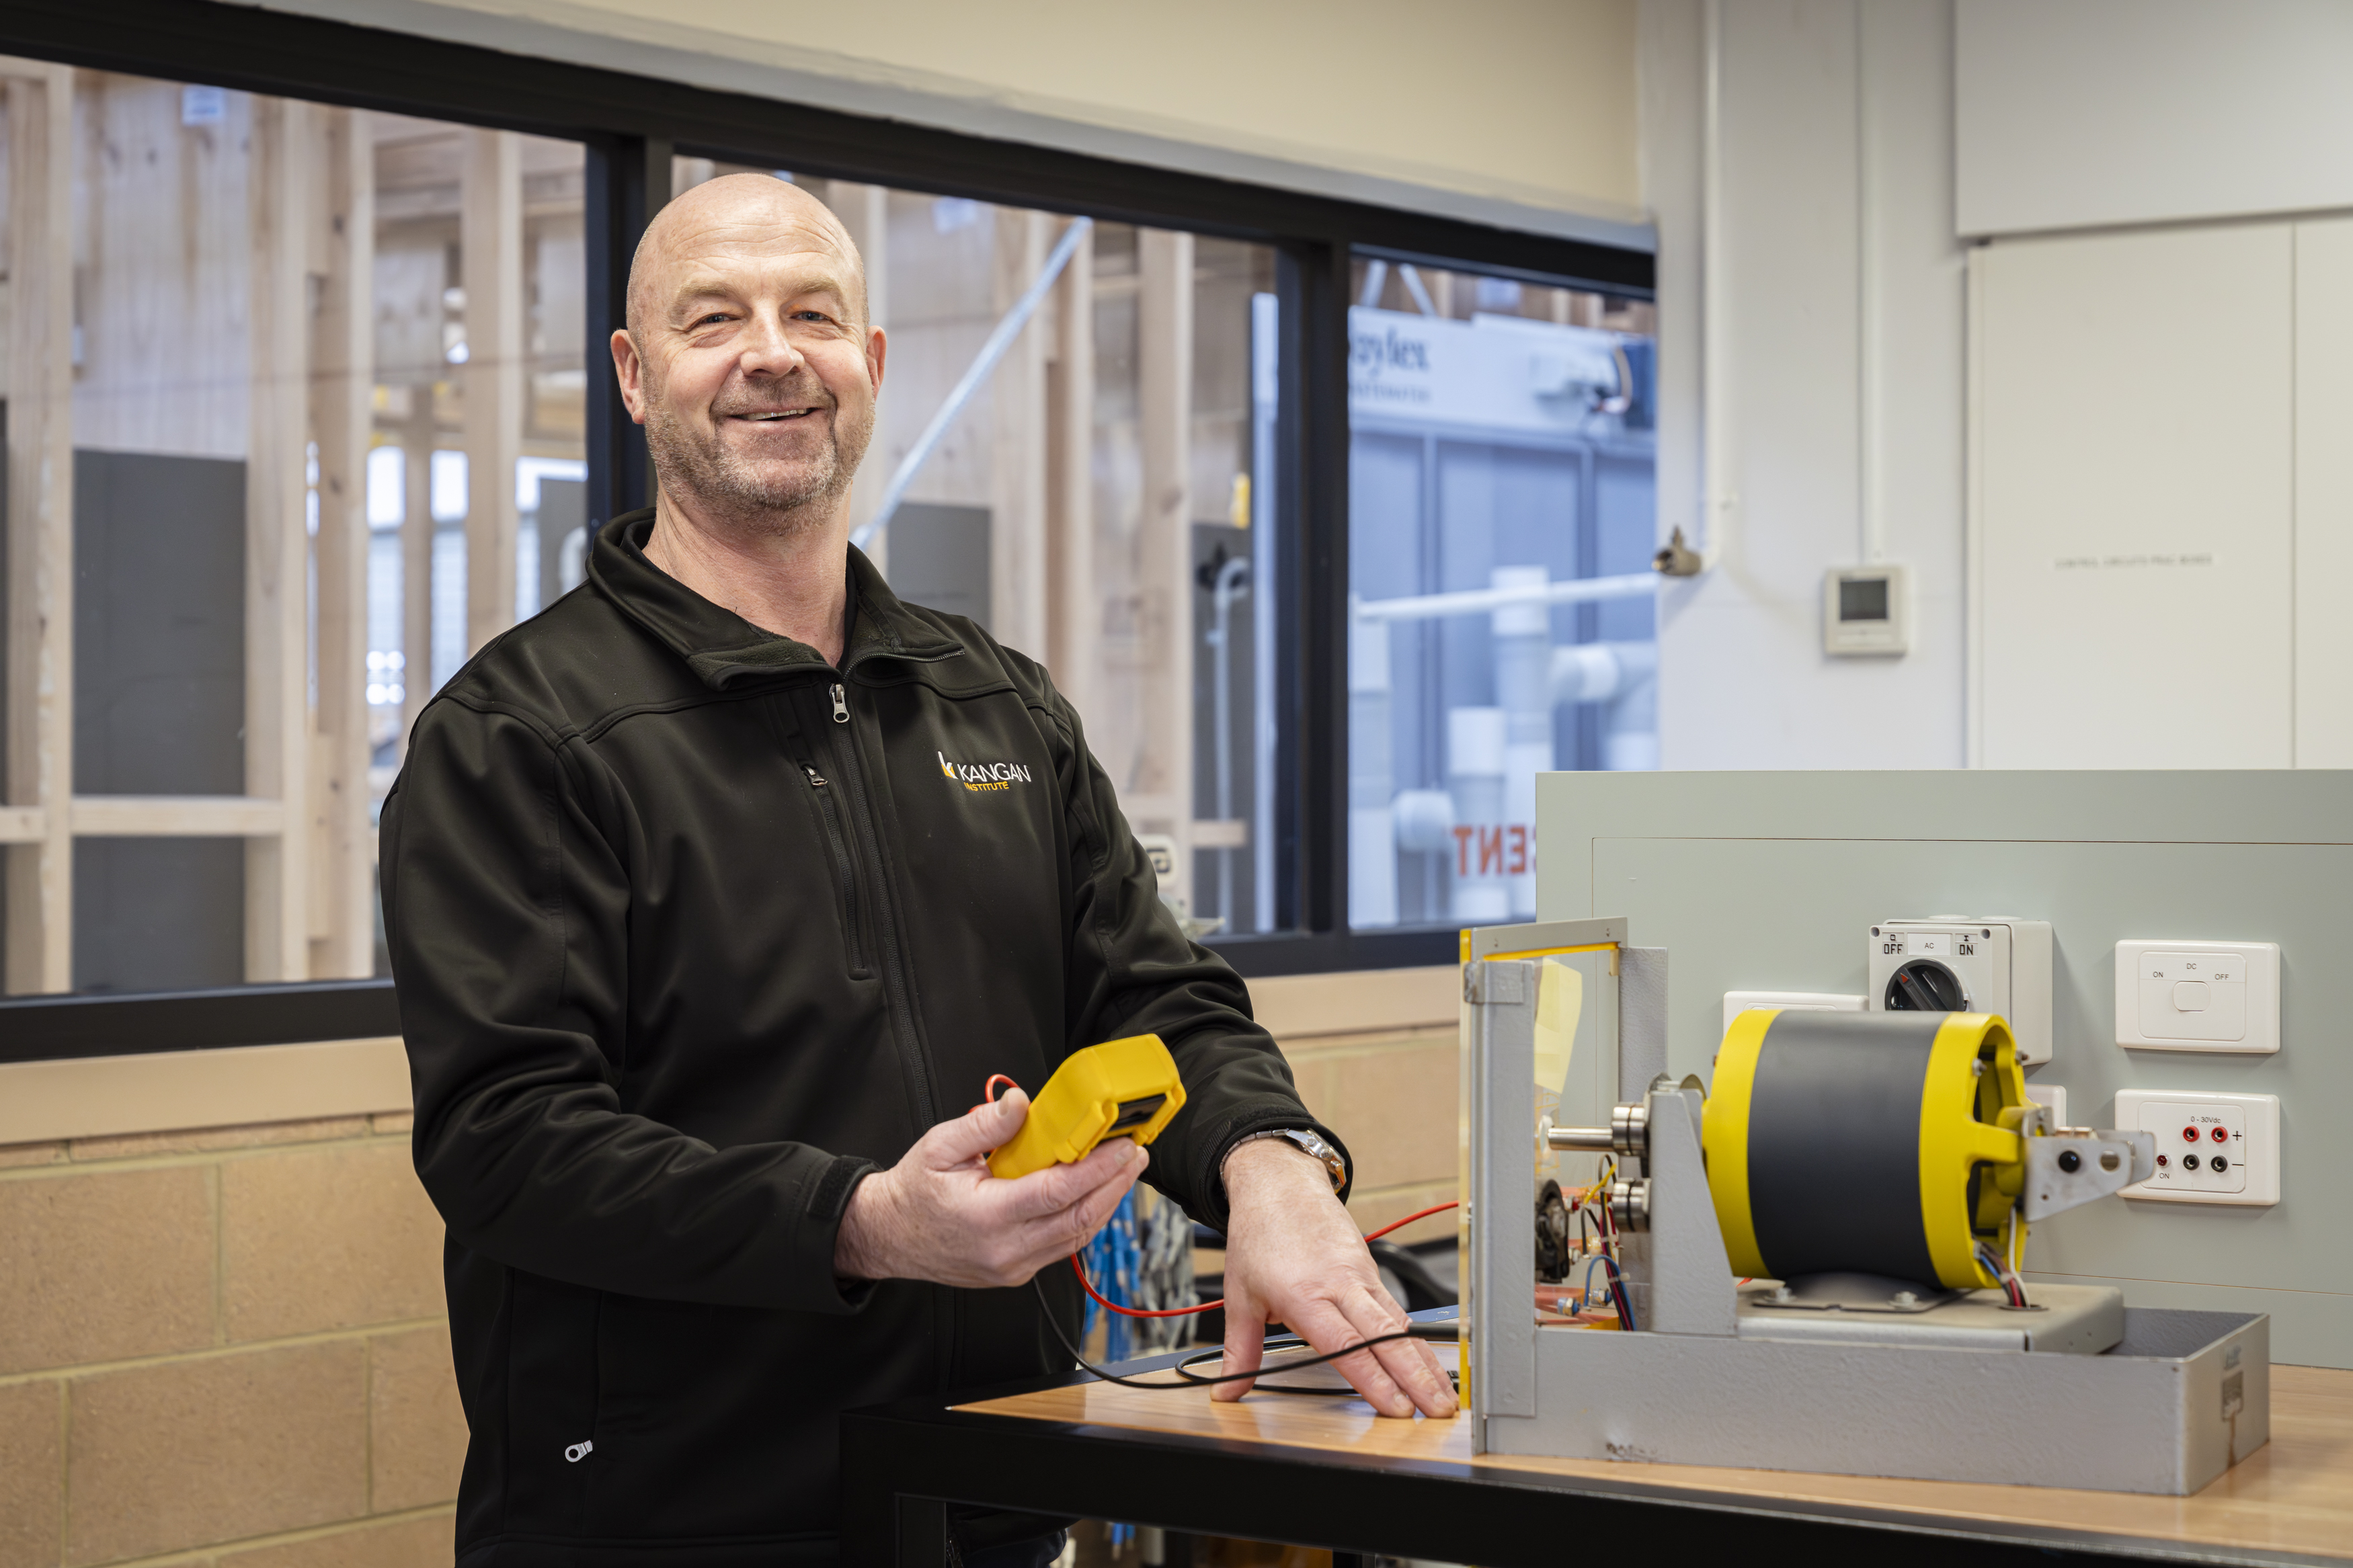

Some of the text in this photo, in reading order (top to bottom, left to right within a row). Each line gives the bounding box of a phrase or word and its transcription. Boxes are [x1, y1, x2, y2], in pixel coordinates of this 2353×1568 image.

[957, 763, 1032, 782] KANGAN
[964, 780, 1010, 792] INSTITUTE
[1884, 944, 1903, 954] OFF
[1959, 944, 1974, 955] ON
